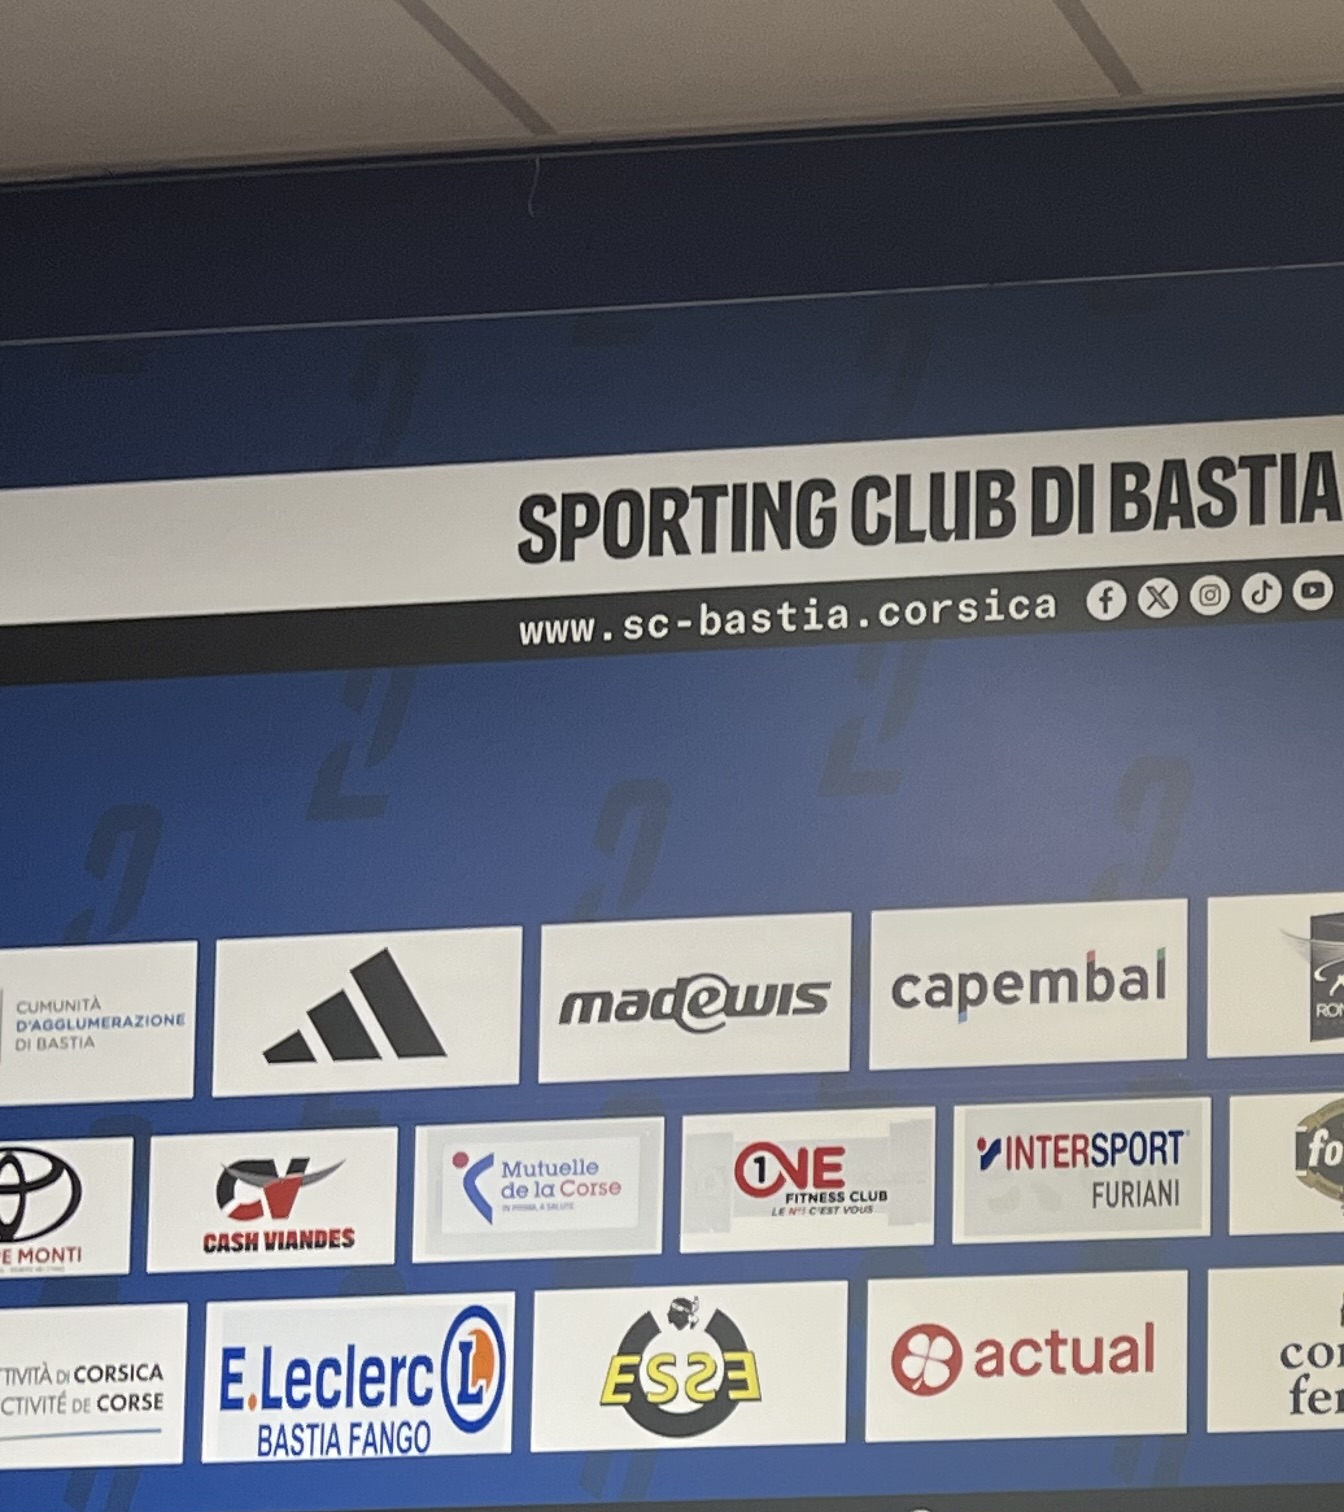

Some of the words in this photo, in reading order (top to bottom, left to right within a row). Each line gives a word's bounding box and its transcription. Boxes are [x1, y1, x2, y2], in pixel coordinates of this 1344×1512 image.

[518, 478, 836, 564] SPORTING
[852, 469, 1016, 545] CLUB
[1032, 464, 1094, 536] DI
[1111, 451, 1342, 532] BASTIA
[520, 589, 1055, 644] www.sc-bastia.corsica
[892, 948, 1165, 1022] capembal
[17, 995, 101, 1014] CUMUNITÀ
[17, 1014, 184, 1032] D'AGGLUMERAZIONE
[15, 1038, 31, 1051] DI
[37, 1036, 95, 1050] BASTIA
[1007, 1130, 1184, 1170] INTERSPORT
[502, 1159, 598, 1178] Mutuelle
[501, 1182, 528, 1199] de
[535, 1181, 554, 1198] la
[560, 1180, 621, 1197] Corse
[786, 1192, 844, 1203] FITNESS
[848, 1190, 888, 1203] CLUB
[1093, 1179, 1179, 1208] FURIANI
[204, 1233, 258, 1253] CASH
[264, 1229, 354, 1250] VIANDES
[975, 1322, 1154, 1377] actual
[74, 1364, 163, 1383] CORSICA
[220, 1344, 433, 1410] E.Leclerc
[97, 1393, 163, 1411] CORSE
[258, 1423, 341, 1456] BASTIA
[349, 1420, 430, 1455] FANGO
